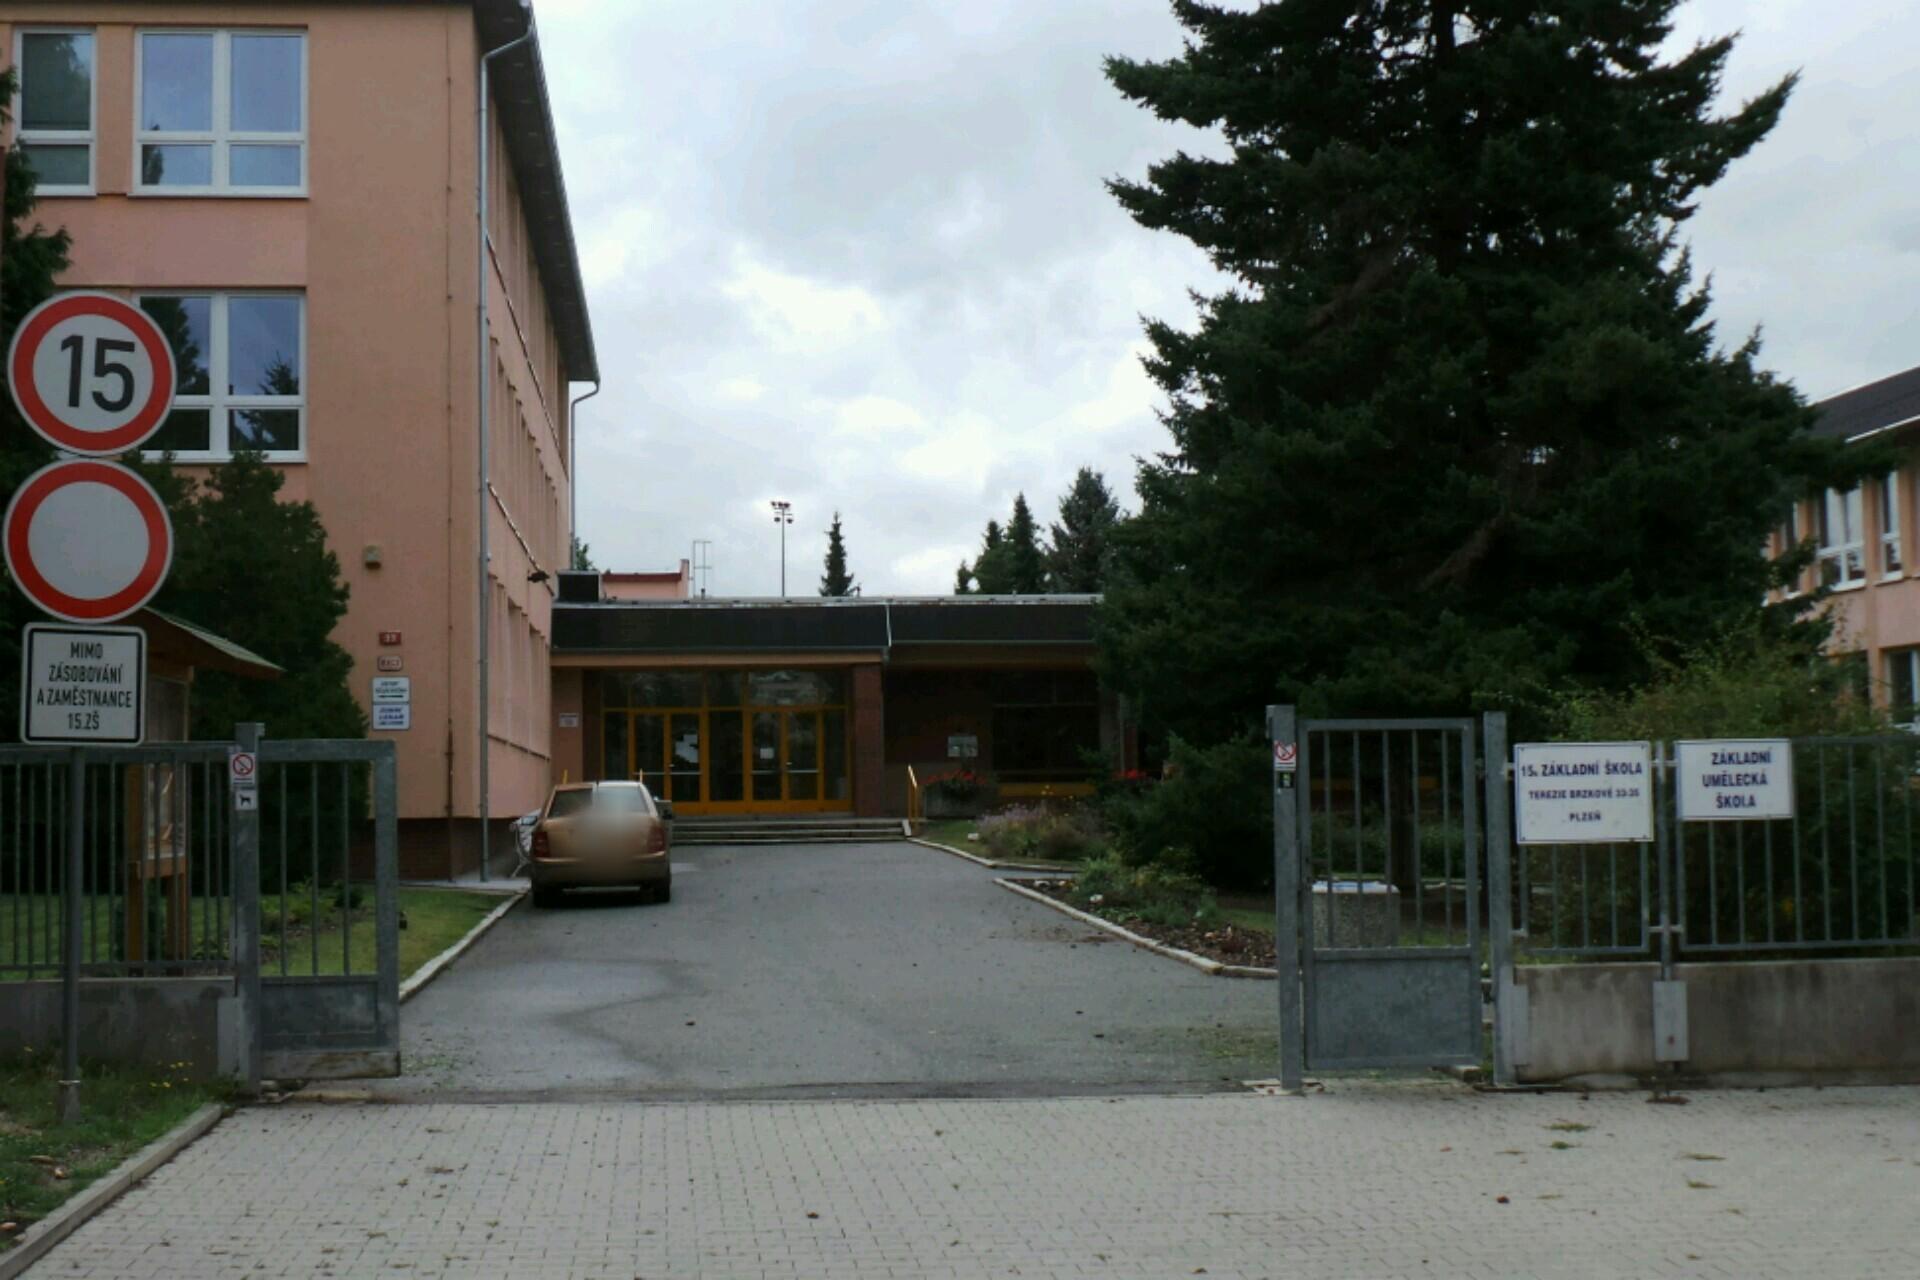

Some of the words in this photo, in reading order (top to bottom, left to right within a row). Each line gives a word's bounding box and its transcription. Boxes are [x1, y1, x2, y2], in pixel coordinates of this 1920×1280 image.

[61, 335, 136, 412] 15
[70, 642, 103, 659] MIMO
[49, 662, 122, 684] ZÁSOBOVÁNÍ
[37, 688, 44, 705] A
[47, 686, 132, 708] ZAMĚSTNANCE
[1711, 747, 1772, 765] ZÁKLADNÍ
[1521, 765, 1538, 777] 15.
[1541, 760, 1599, 776] ZÁKLADNÍ
[1605, 759, 1643, 775] ŠKOLA
[1716, 791, 1756, 808] ŠKOLA
[1569, 809, 1601, 822] PLZEŇ
